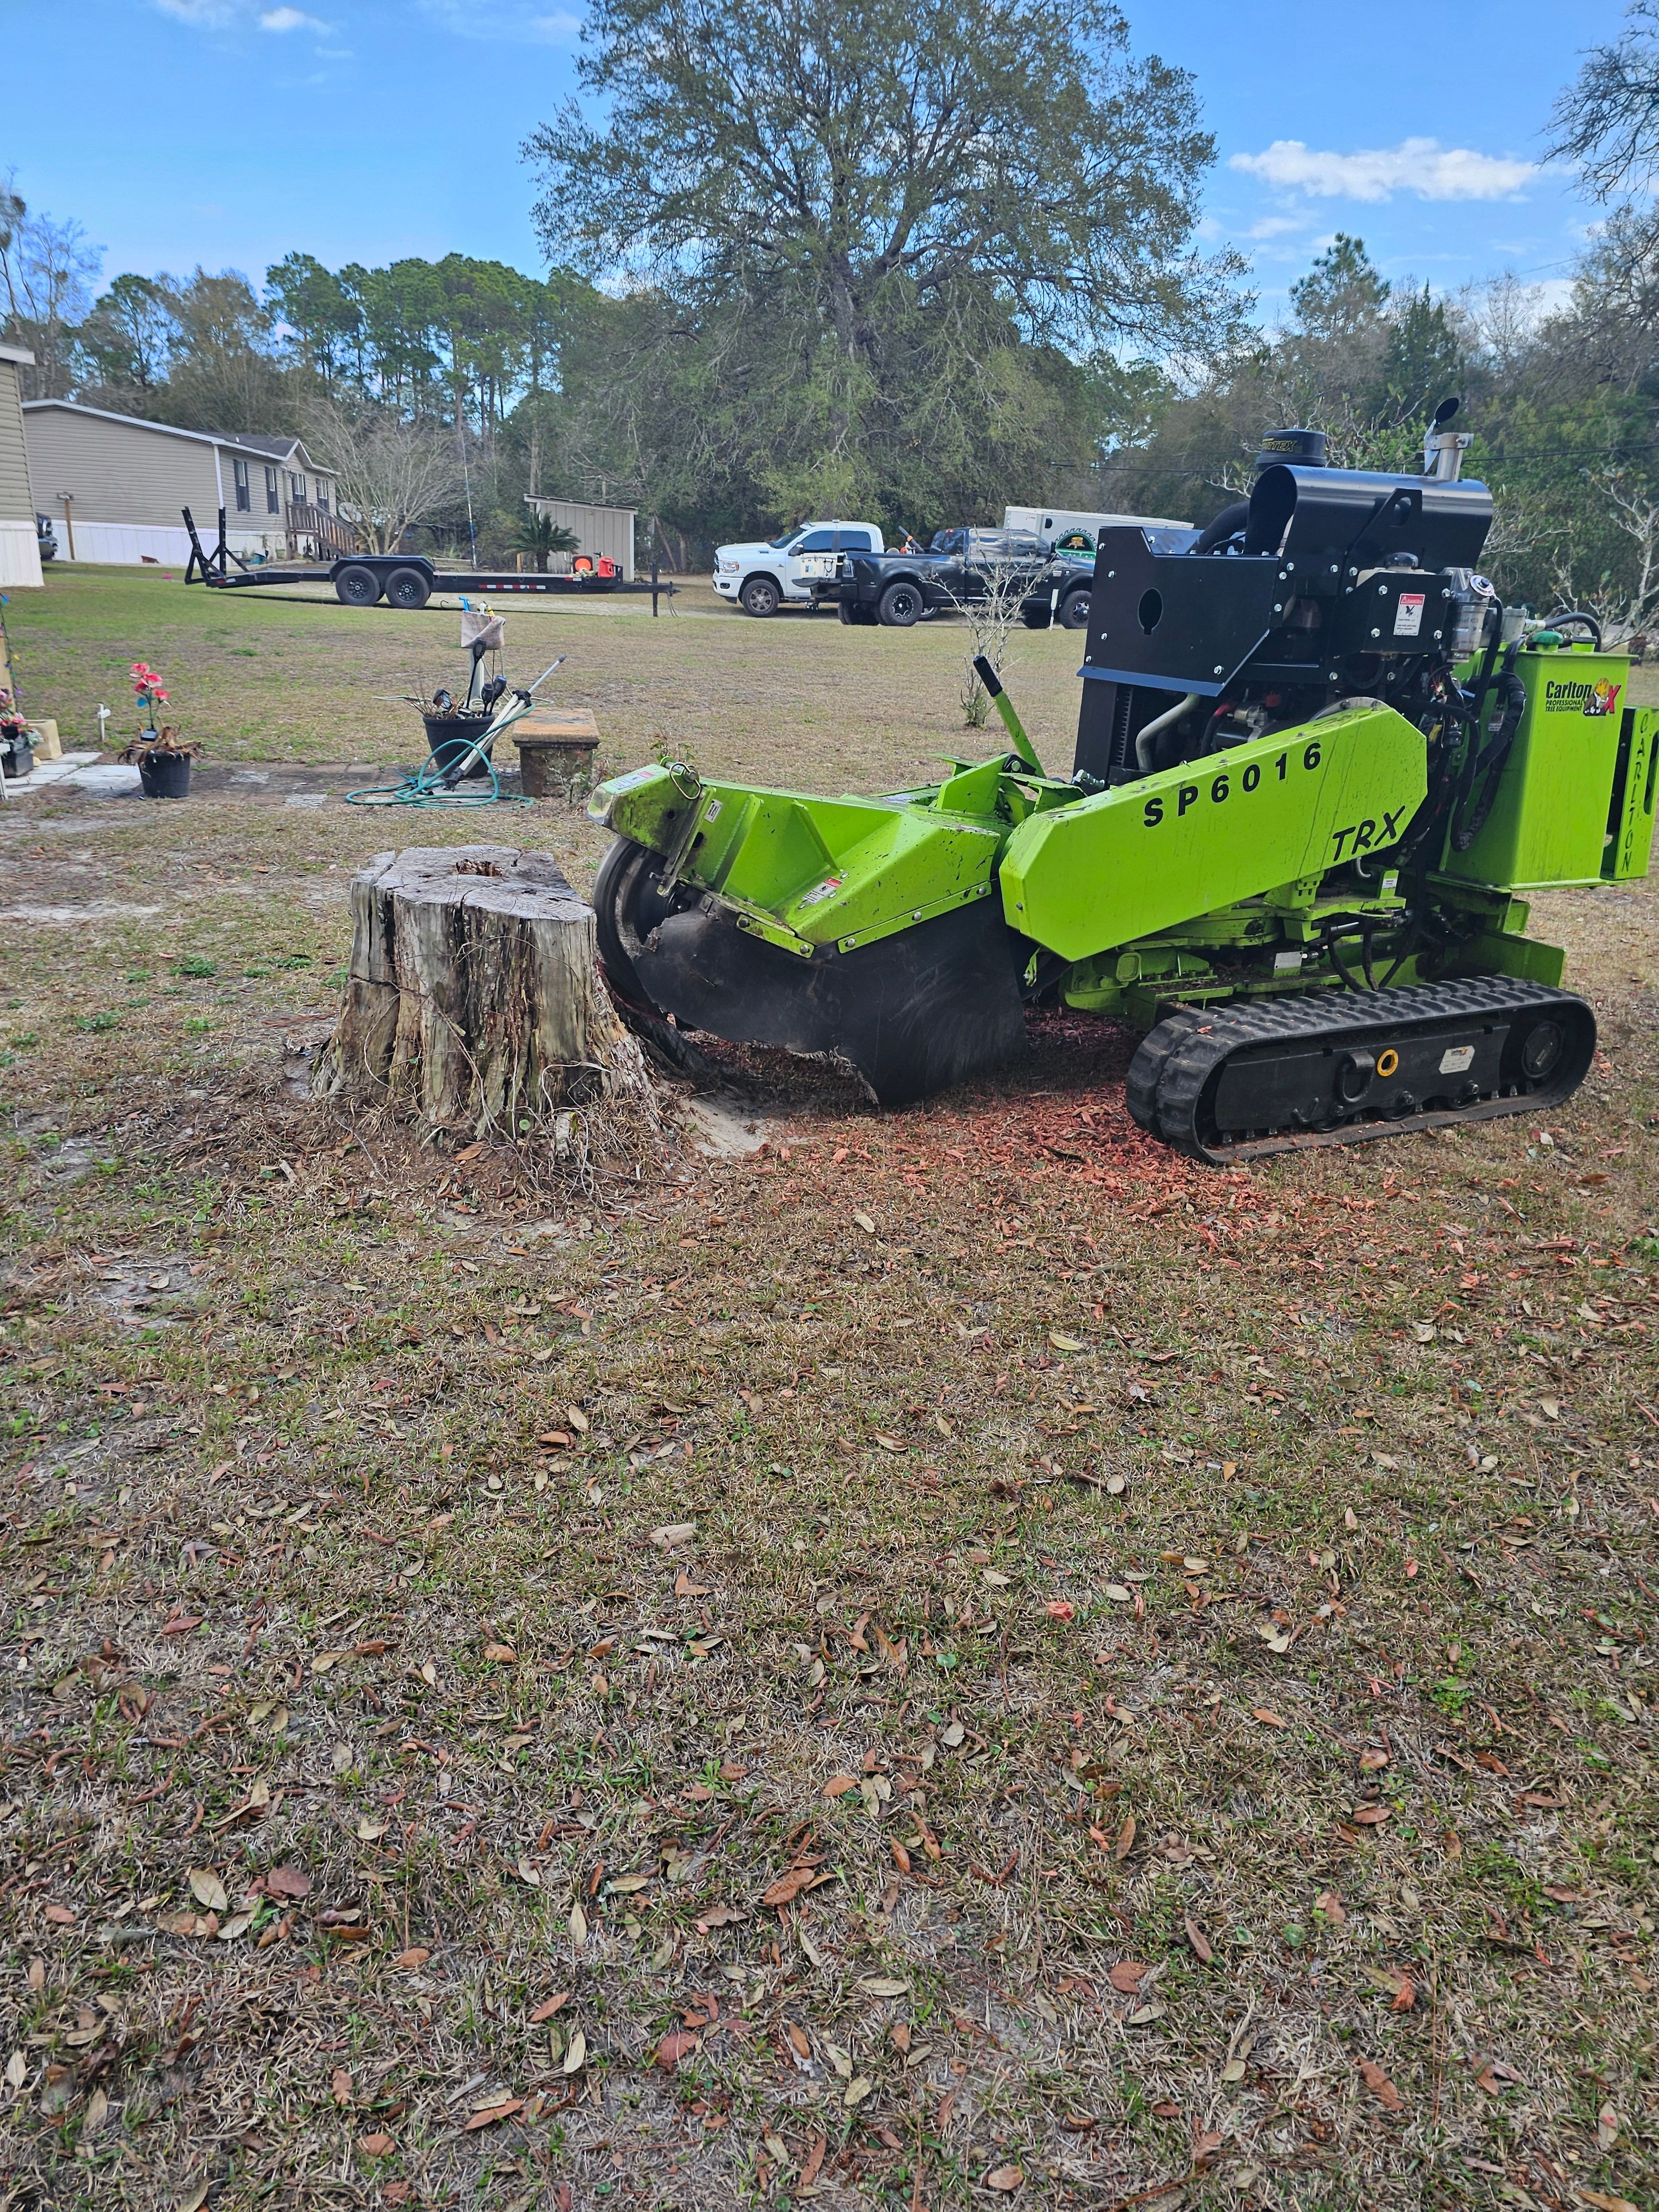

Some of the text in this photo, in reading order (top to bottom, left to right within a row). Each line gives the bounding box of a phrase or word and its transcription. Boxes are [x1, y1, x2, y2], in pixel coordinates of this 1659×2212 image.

[1546, 681, 1592, 698] Carlton
[1144, 742, 1322, 827] SP6016
[1621, 713, 1648, 872] CARLTON
[1333, 806, 1405, 862] TRX
